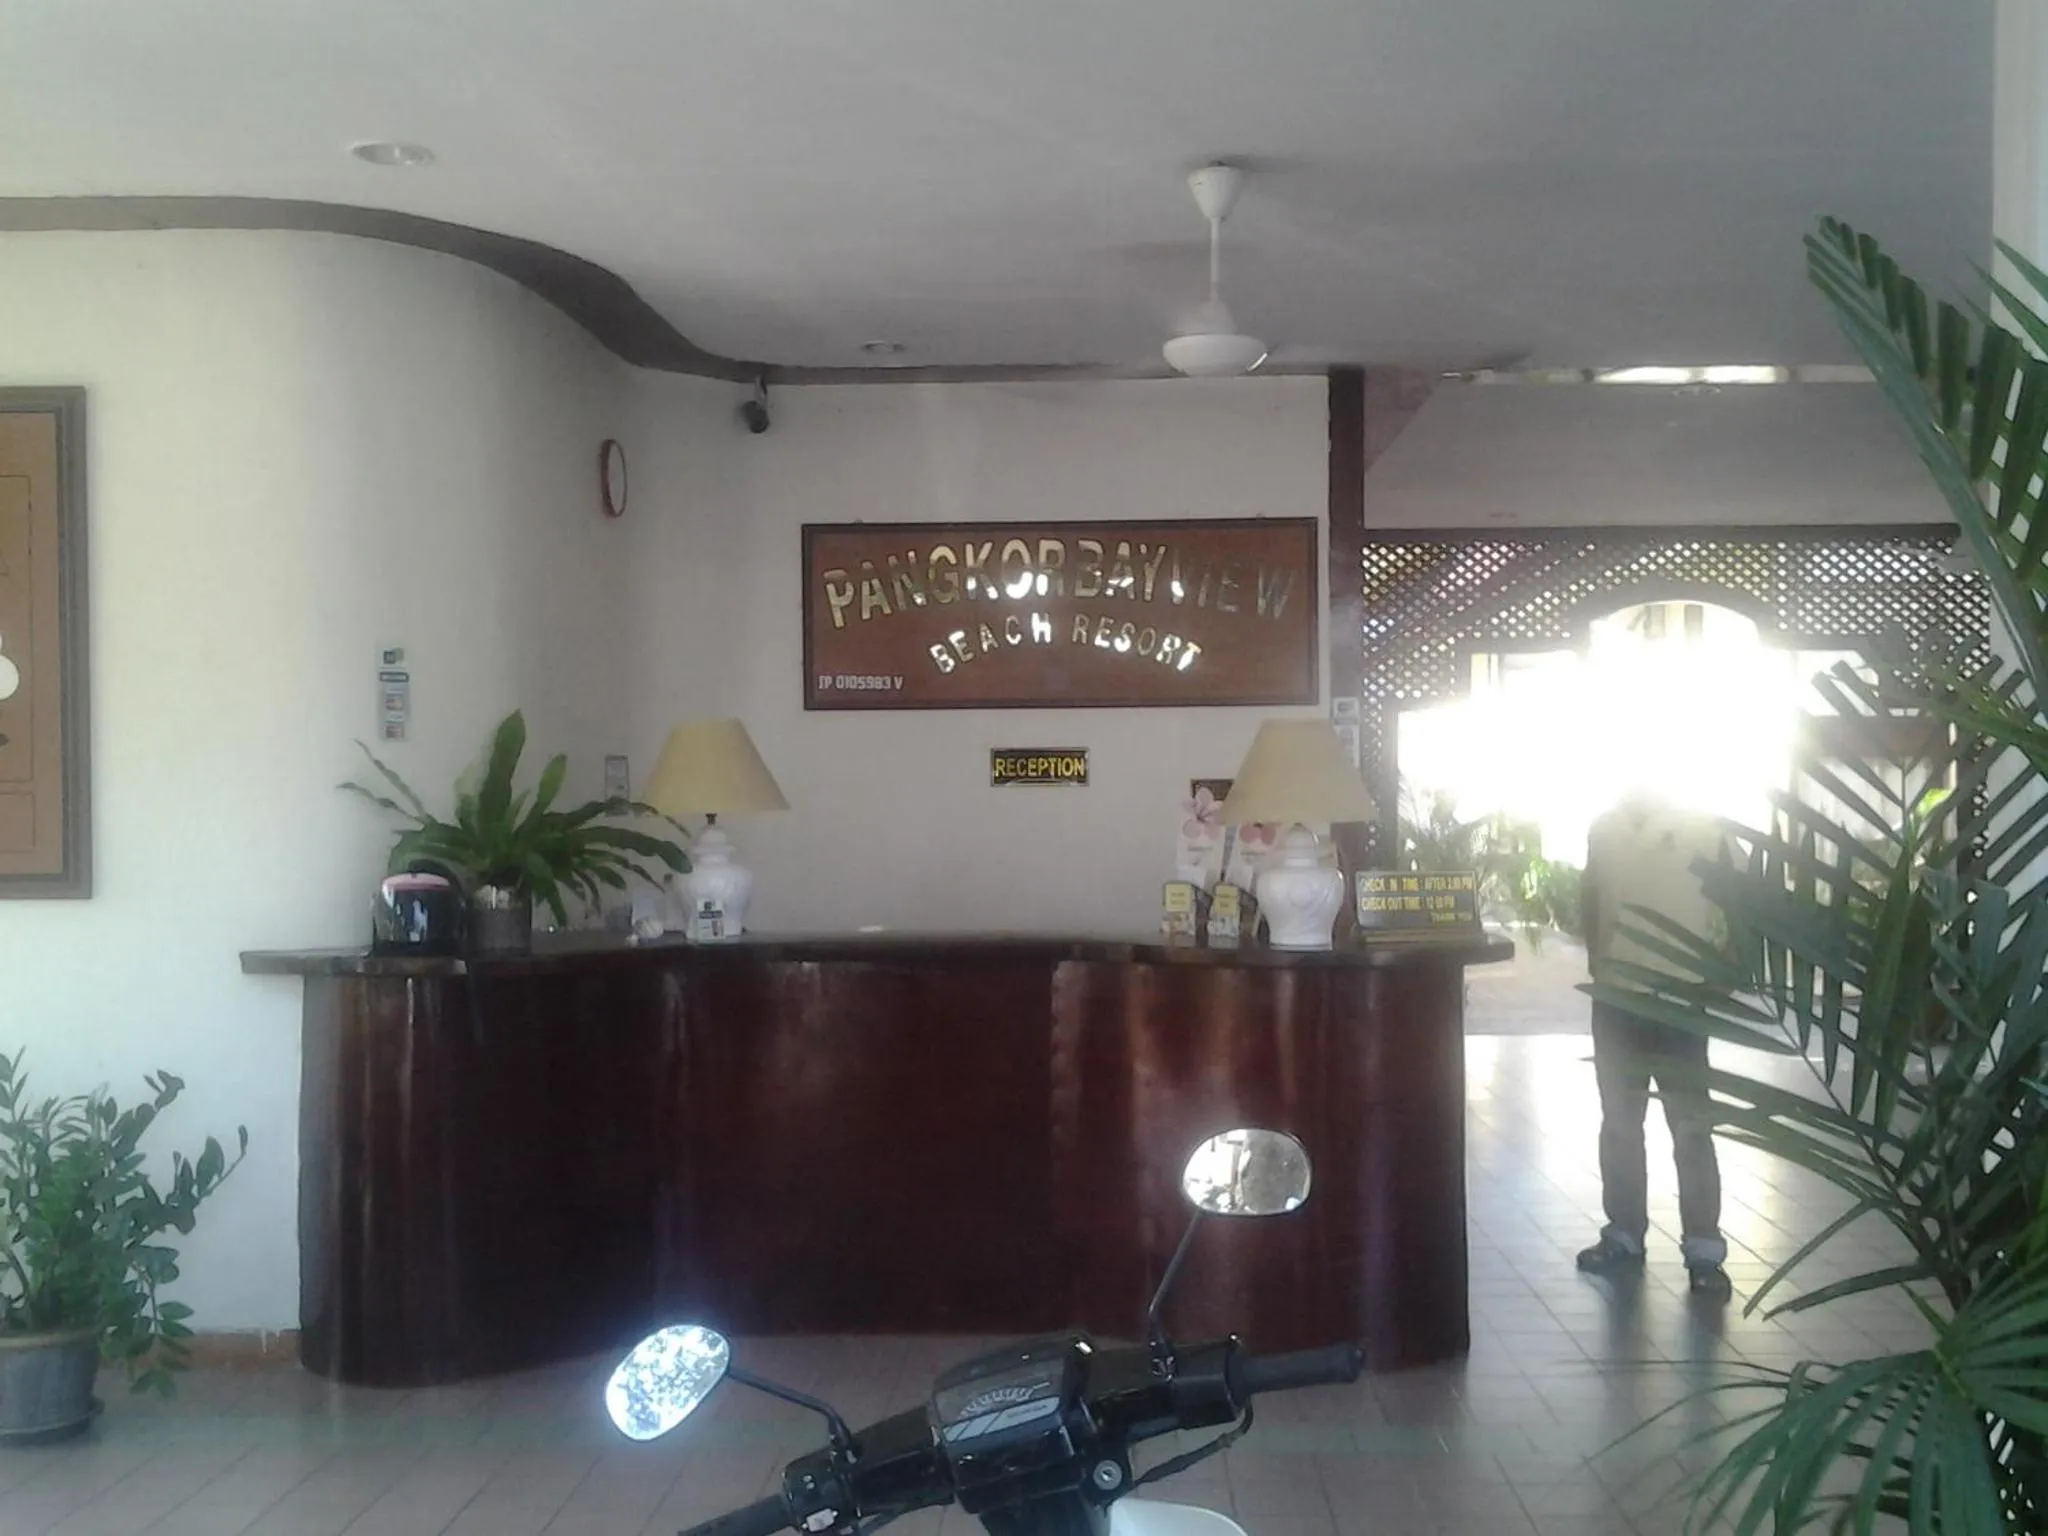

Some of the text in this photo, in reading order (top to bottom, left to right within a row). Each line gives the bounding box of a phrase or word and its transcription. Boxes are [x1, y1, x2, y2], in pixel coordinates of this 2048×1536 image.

[823, 539, 1066, 628] PANGKOR
[929, 612, 1202, 673] BEACH RESORT
[893, 676, 904, 690] V
[995, 757, 1085, 777] RECEPTION
[1361, 896, 1386, 912] CHECK
